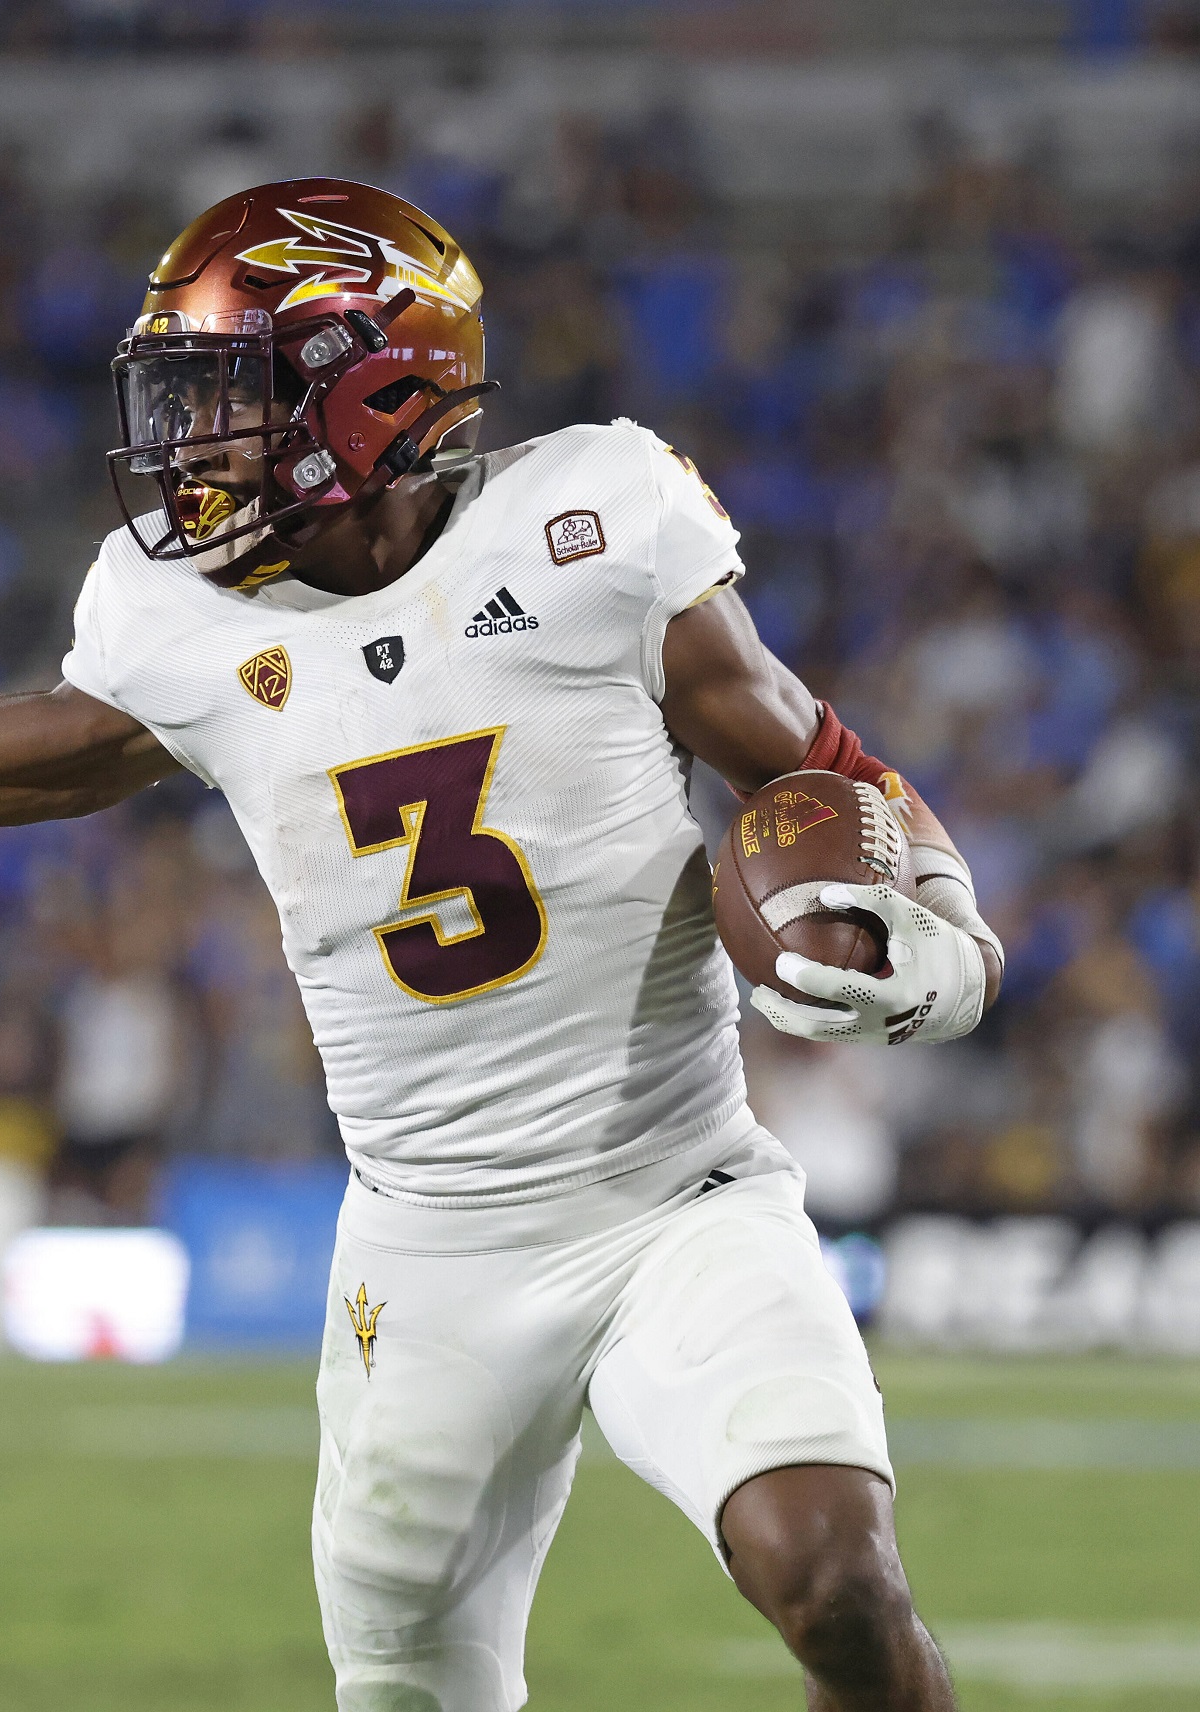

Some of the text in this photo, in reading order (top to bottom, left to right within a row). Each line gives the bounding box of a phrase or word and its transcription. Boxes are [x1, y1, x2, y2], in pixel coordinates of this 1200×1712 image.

[151, 317, 169, 334] 42
[465, 616, 539, 638] adidas
[375, 643, 390, 656] PT
[241, 650, 287, 695] PAC
[379, 658, 394, 670] 42
[259, 674, 286, 702] 12
[326, 724, 549, 1006] 3
